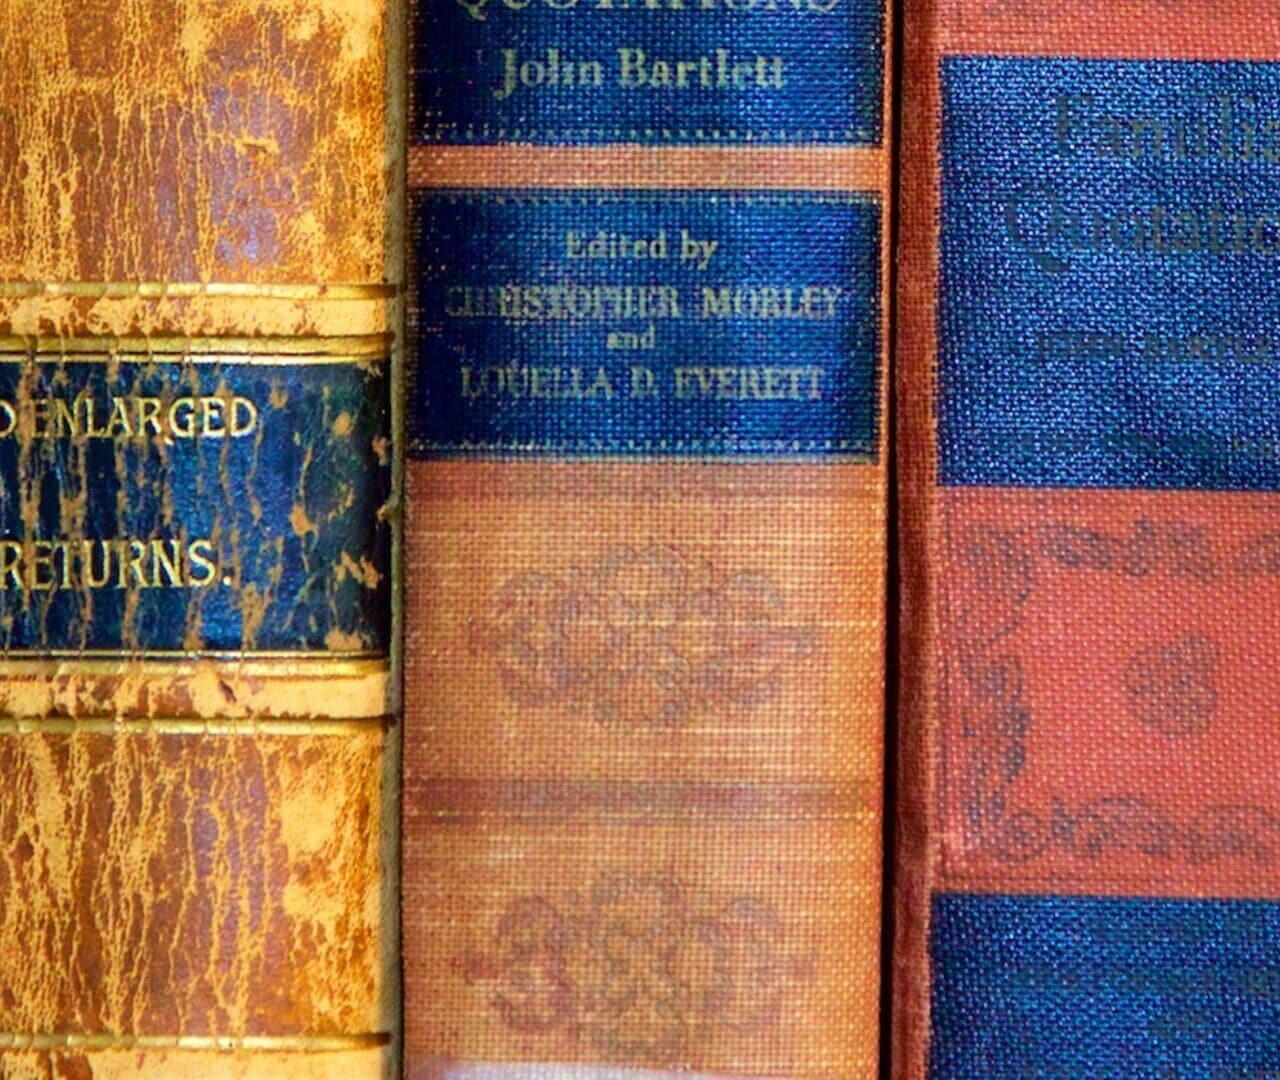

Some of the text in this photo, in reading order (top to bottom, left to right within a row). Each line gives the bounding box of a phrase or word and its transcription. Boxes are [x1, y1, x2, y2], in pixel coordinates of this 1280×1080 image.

[493, 47, 784, 100] John Bartlett
[566, 230, 718, 268] Edited by
[702, 284, 843, 318] MORLEY
[606, 326, 656, 350] and
[29, 390, 258, 445] ENLARGED
